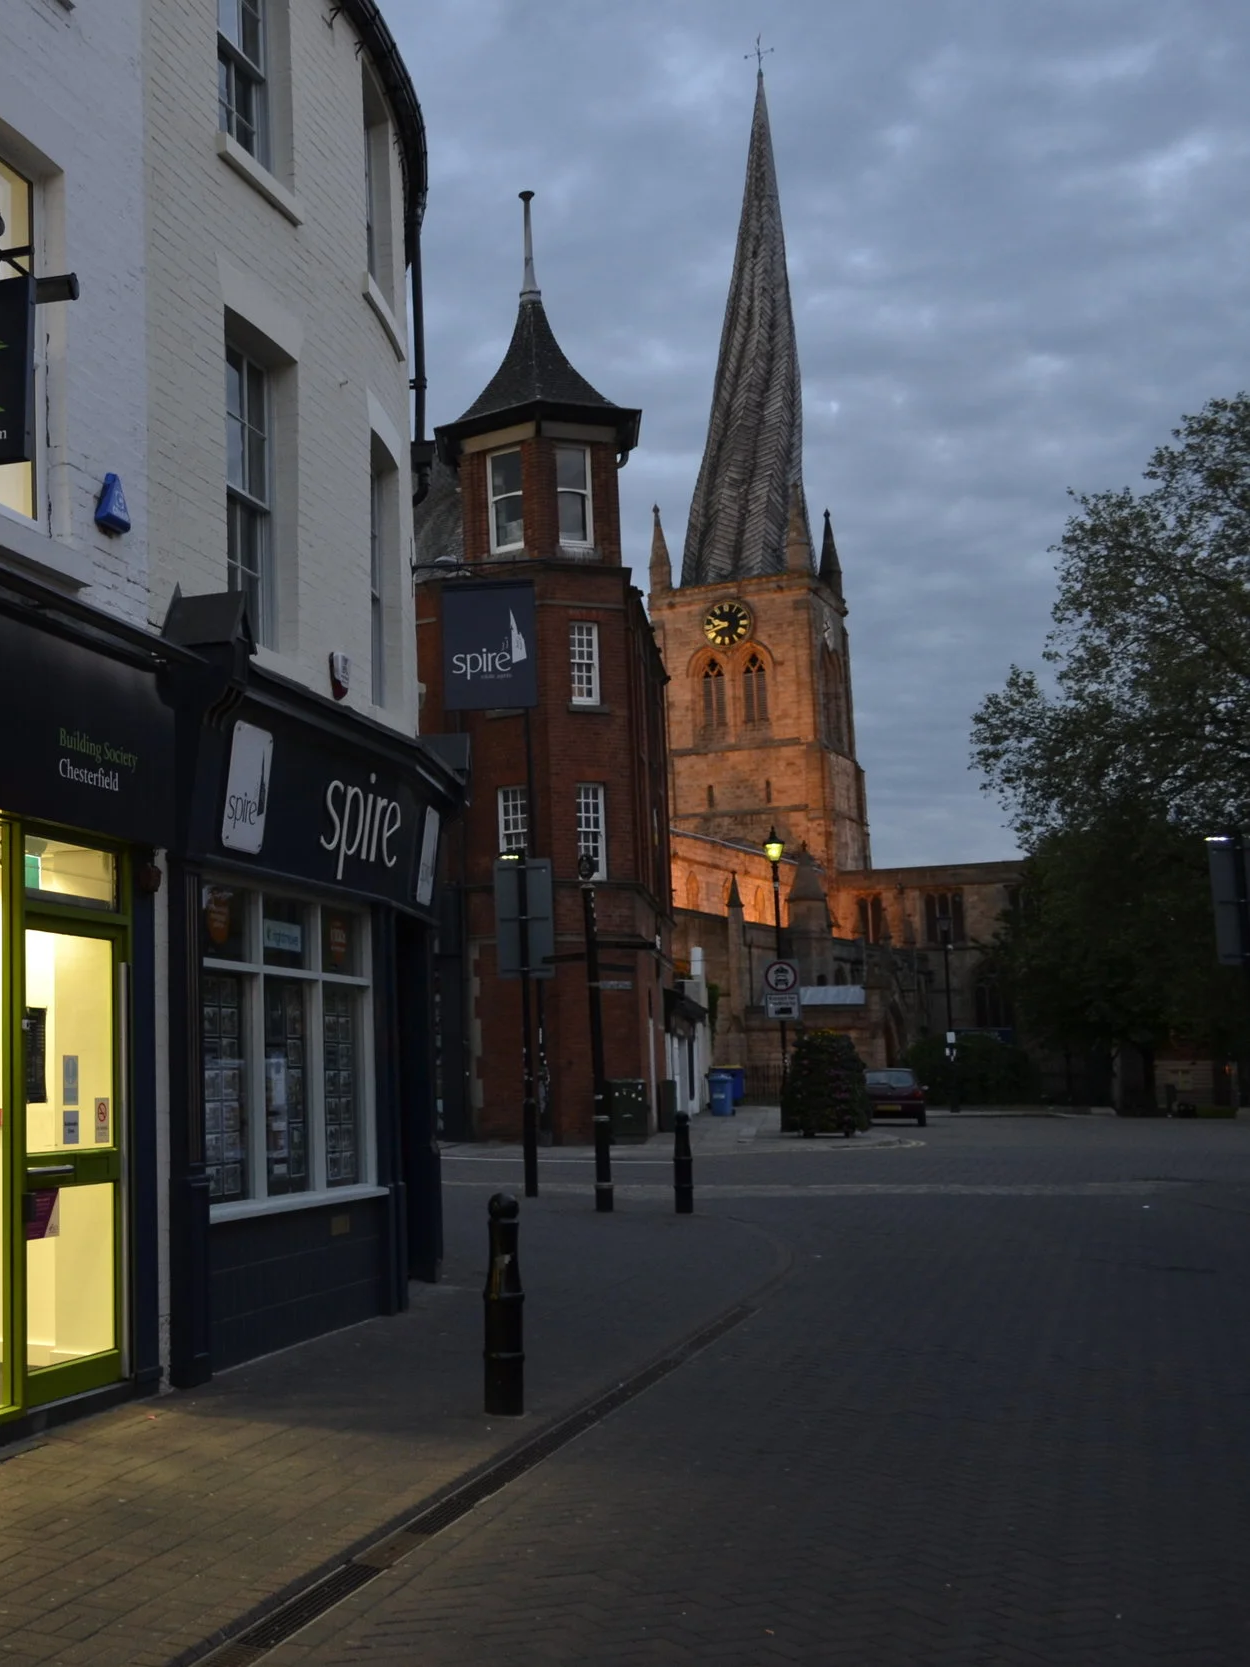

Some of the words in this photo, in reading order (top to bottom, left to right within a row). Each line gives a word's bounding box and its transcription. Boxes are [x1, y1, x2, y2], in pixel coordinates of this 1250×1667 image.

[452, 647, 512, 681] spire
[59, 726, 102, 764] Building
[103, 741, 138, 774] Society
[58, 757, 119, 792] Chesterfield
[226, 791, 258, 830] spire
[320, 771, 402, 881] spire
